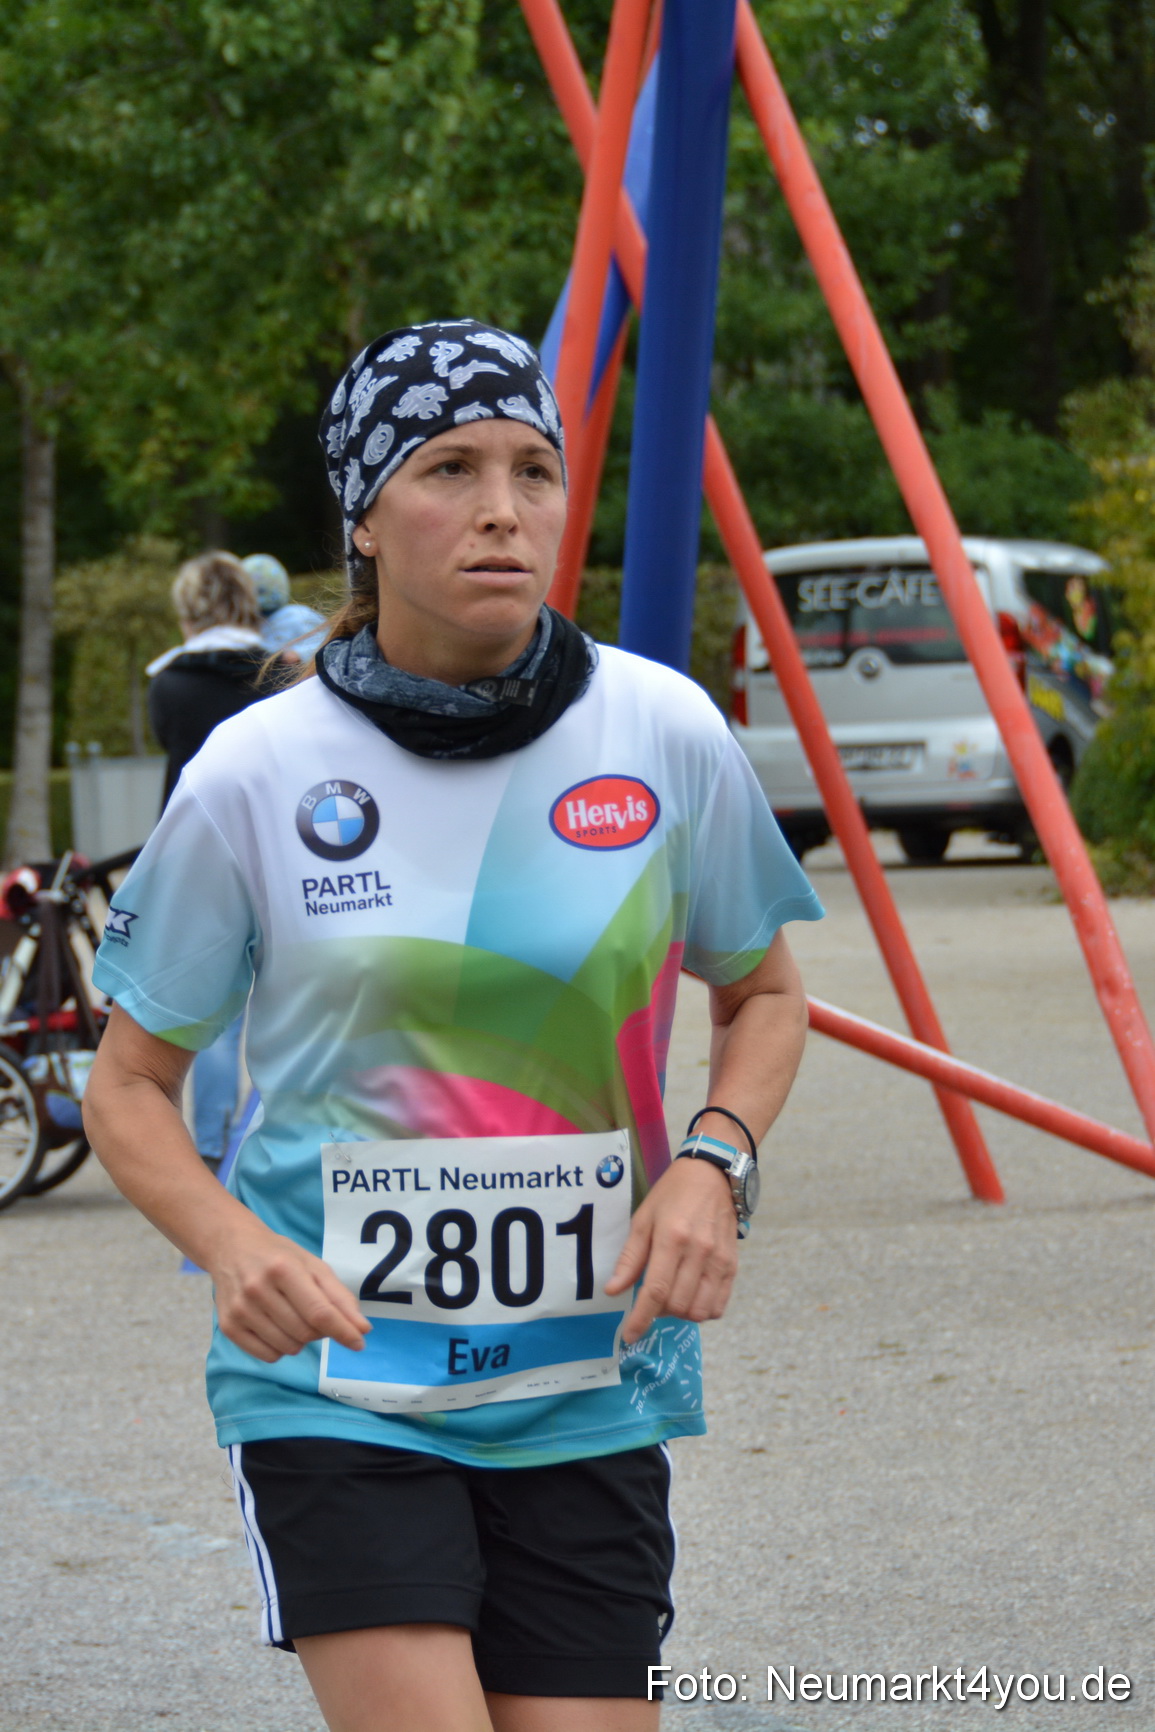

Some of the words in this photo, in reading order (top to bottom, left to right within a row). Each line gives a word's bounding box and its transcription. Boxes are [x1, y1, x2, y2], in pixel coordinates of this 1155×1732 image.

[301, 782, 371, 810] BMW
[565, 796, 649, 829] Hervis
[576, 826, 617, 838] SPORTS
[302, 870, 391, 900] PARTL
[305, 893, 393, 916] Neumarkt
[332, 1168, 431, 1193] PARTL
[440, 1164, 584, 1190] Neumarkt
[359, 1203, 594, 1310] 2801
[678, 1329, 697, 1354] 2015
[448, 1338, 510, 1375] Eva
